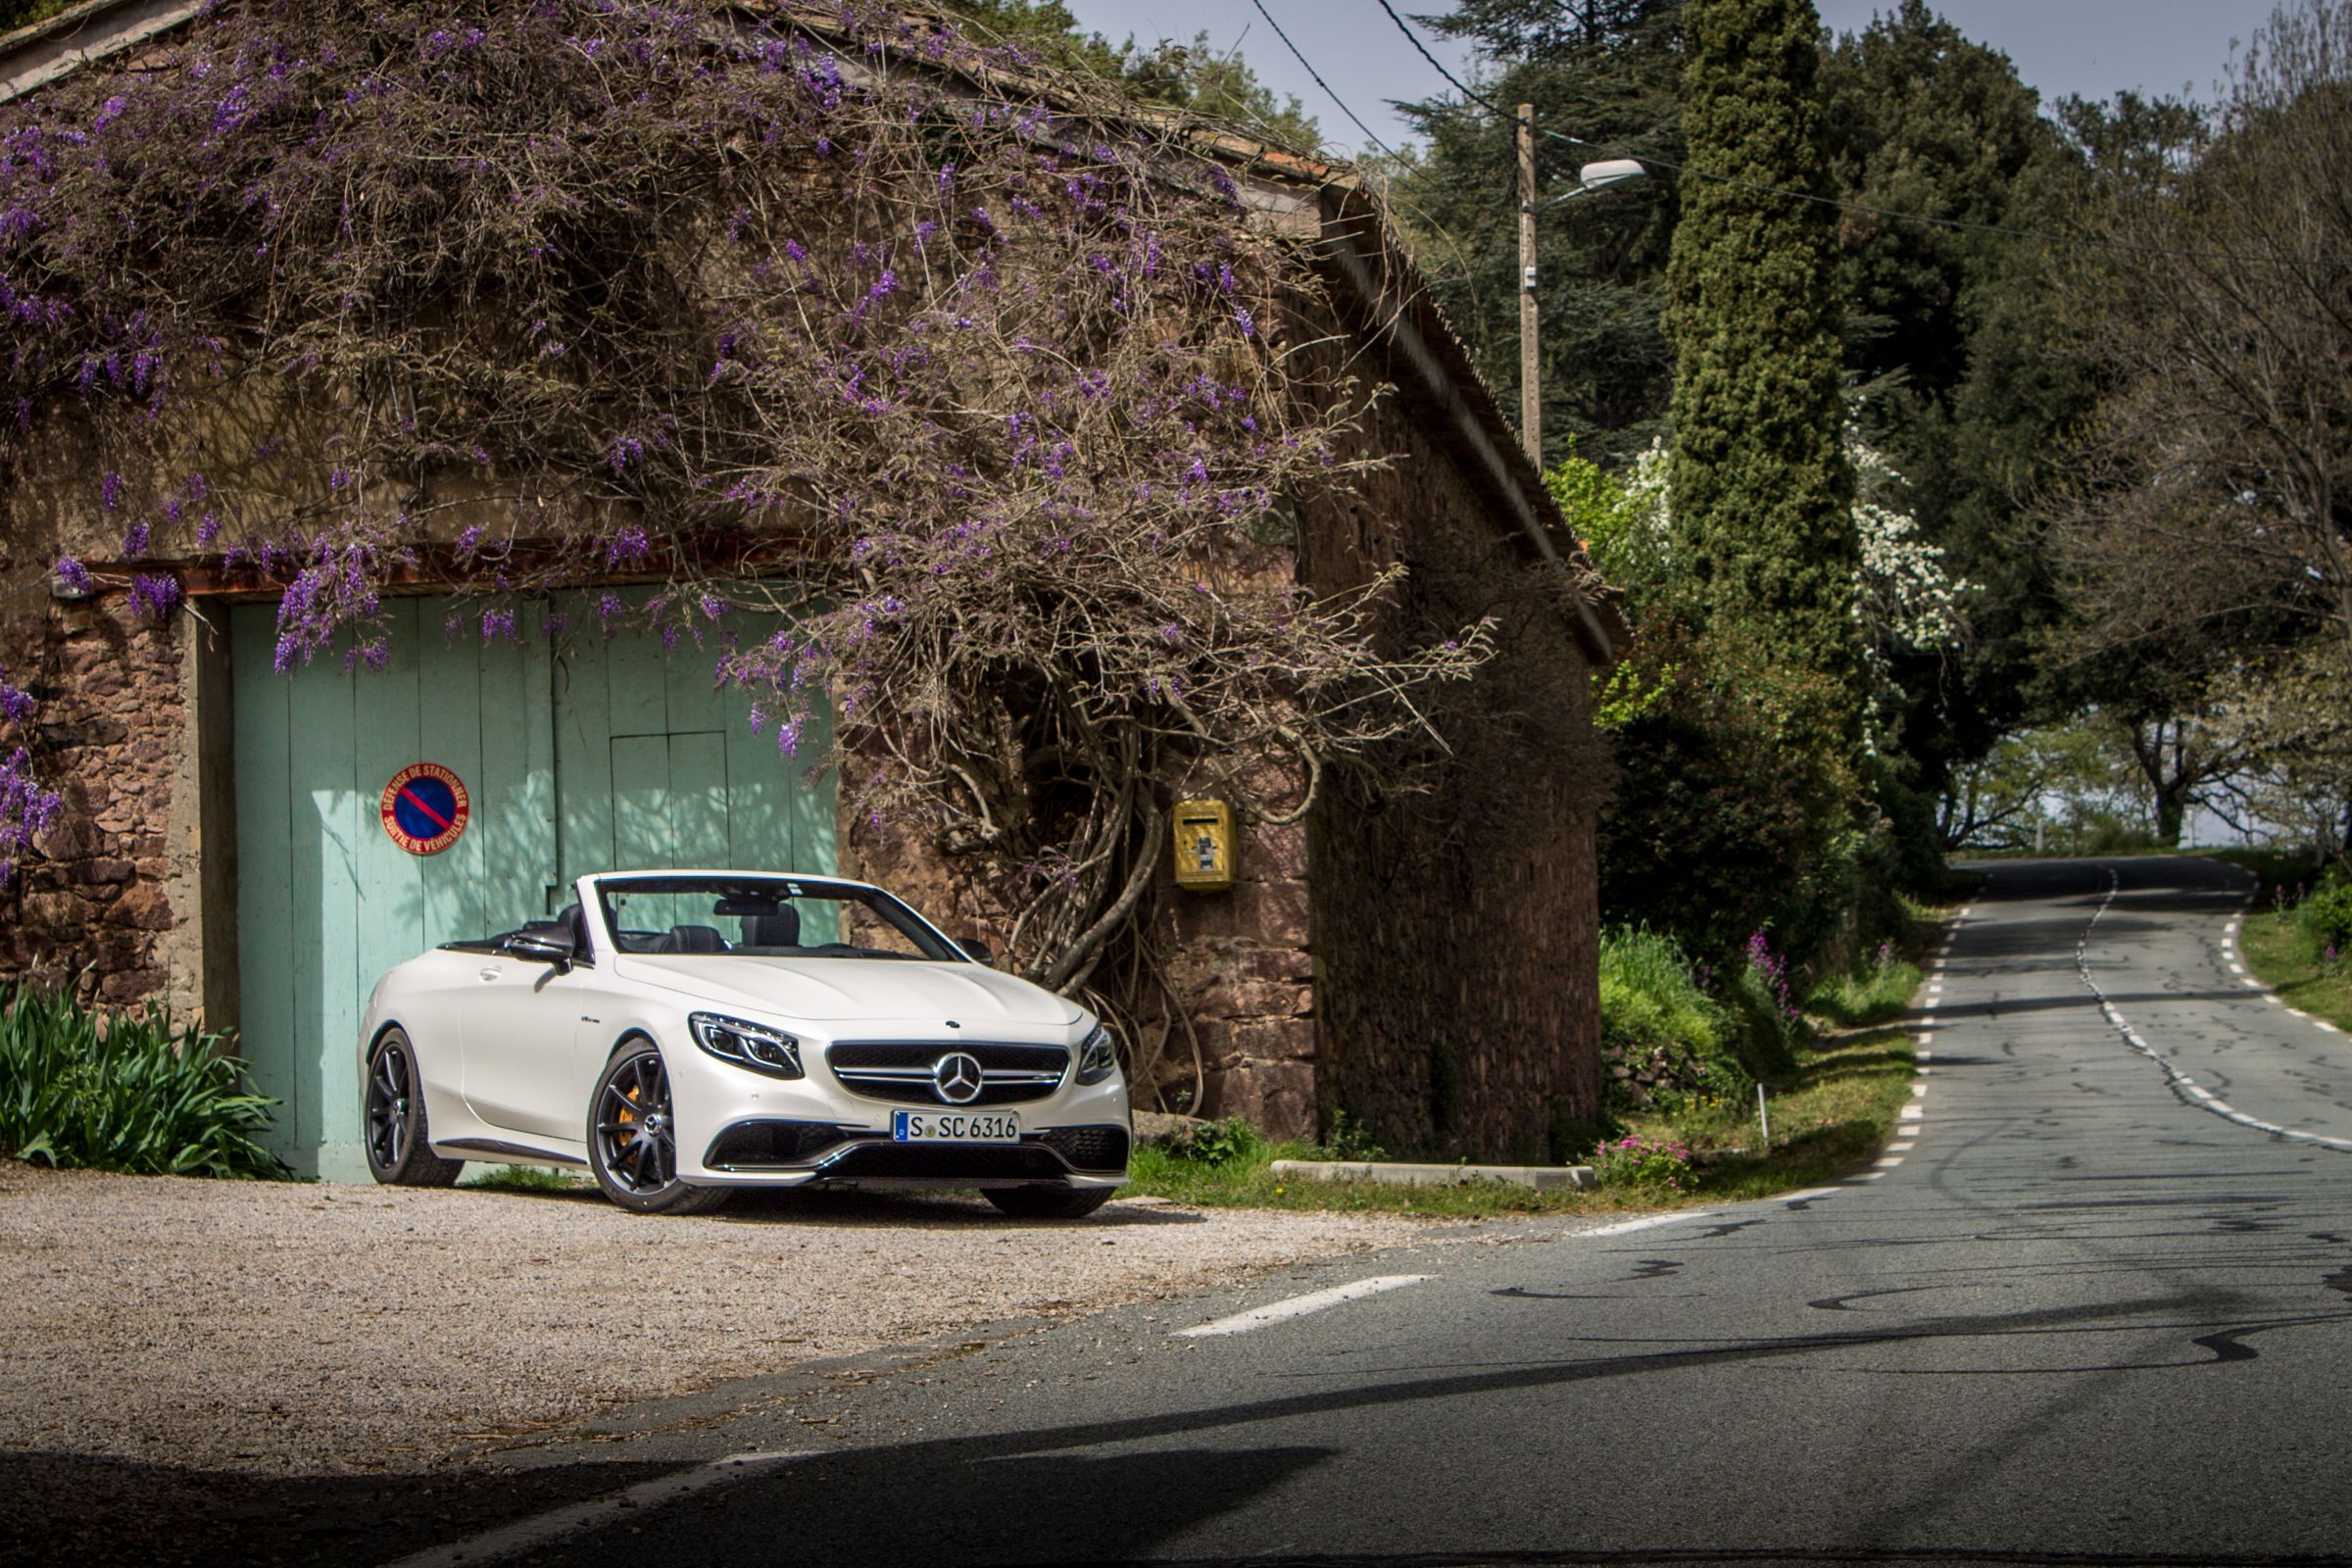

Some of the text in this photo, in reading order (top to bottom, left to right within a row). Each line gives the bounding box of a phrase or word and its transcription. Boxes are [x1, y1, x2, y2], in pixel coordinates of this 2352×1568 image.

[409, 766, 421, 777] DE
[422, 764, 466, 808] STATIONNER
[384, 815, 409, 847] SORTIE
[409, 839, 421, 851] DE
[910, 1116, 1015, 1138] S SC 6316
